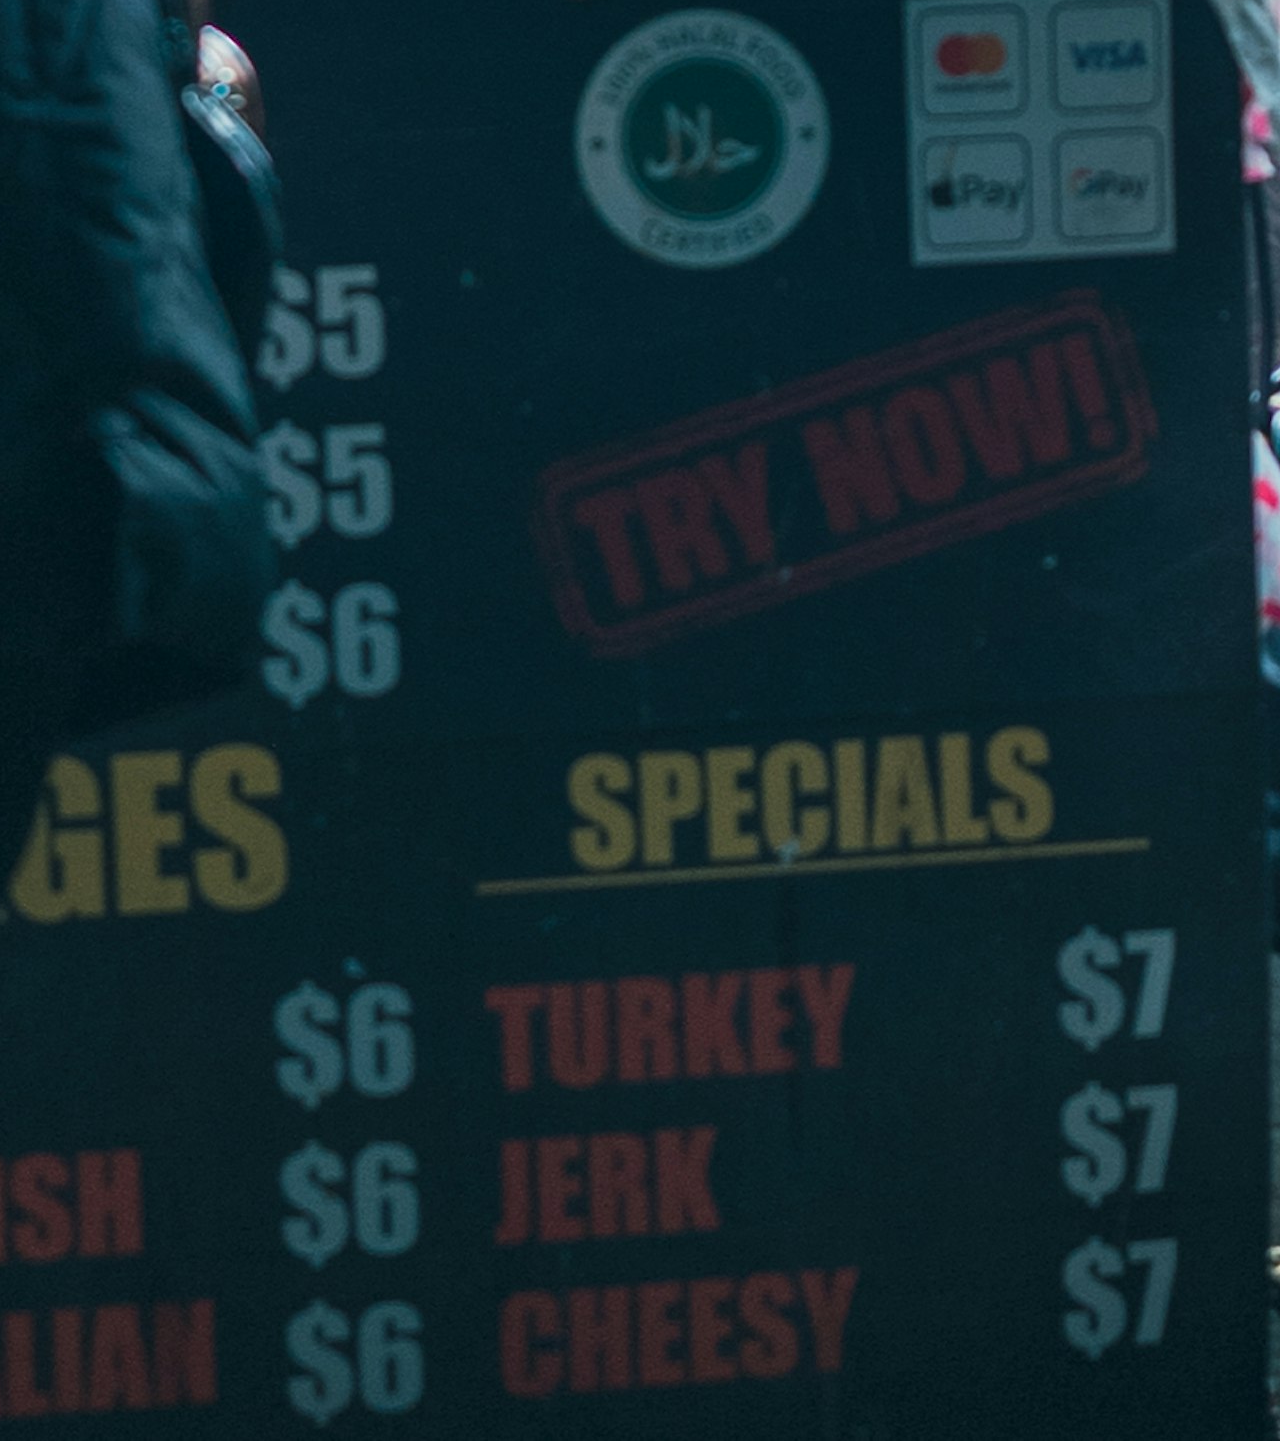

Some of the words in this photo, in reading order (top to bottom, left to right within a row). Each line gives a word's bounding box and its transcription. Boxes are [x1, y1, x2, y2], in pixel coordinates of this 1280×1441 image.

[256, 261, 388, 390] $5
[257, 420, 396, 548] $5
[574, 445, 784, 610] TRY
[803, 330, 1119, 538] NOW!
[260, 576, 403, 711] $6
[566, 726, 1056, 871] SPECIALS
[274, 978, 419, 1111] $6
[485, 962, 856, 1091] TURKEY
[1057, 924, 1178, 1052] $7
[282, 1139, 422, 1267] $6
[495, 1126, 723, 1245] JERK
[1060, 1081, 1180, 1207] $7
[498, 1267, 860, 1398] CHEESY
[1062, 1235, 1181, 1359] $7
[287, 1298, 426, 1429] $6
